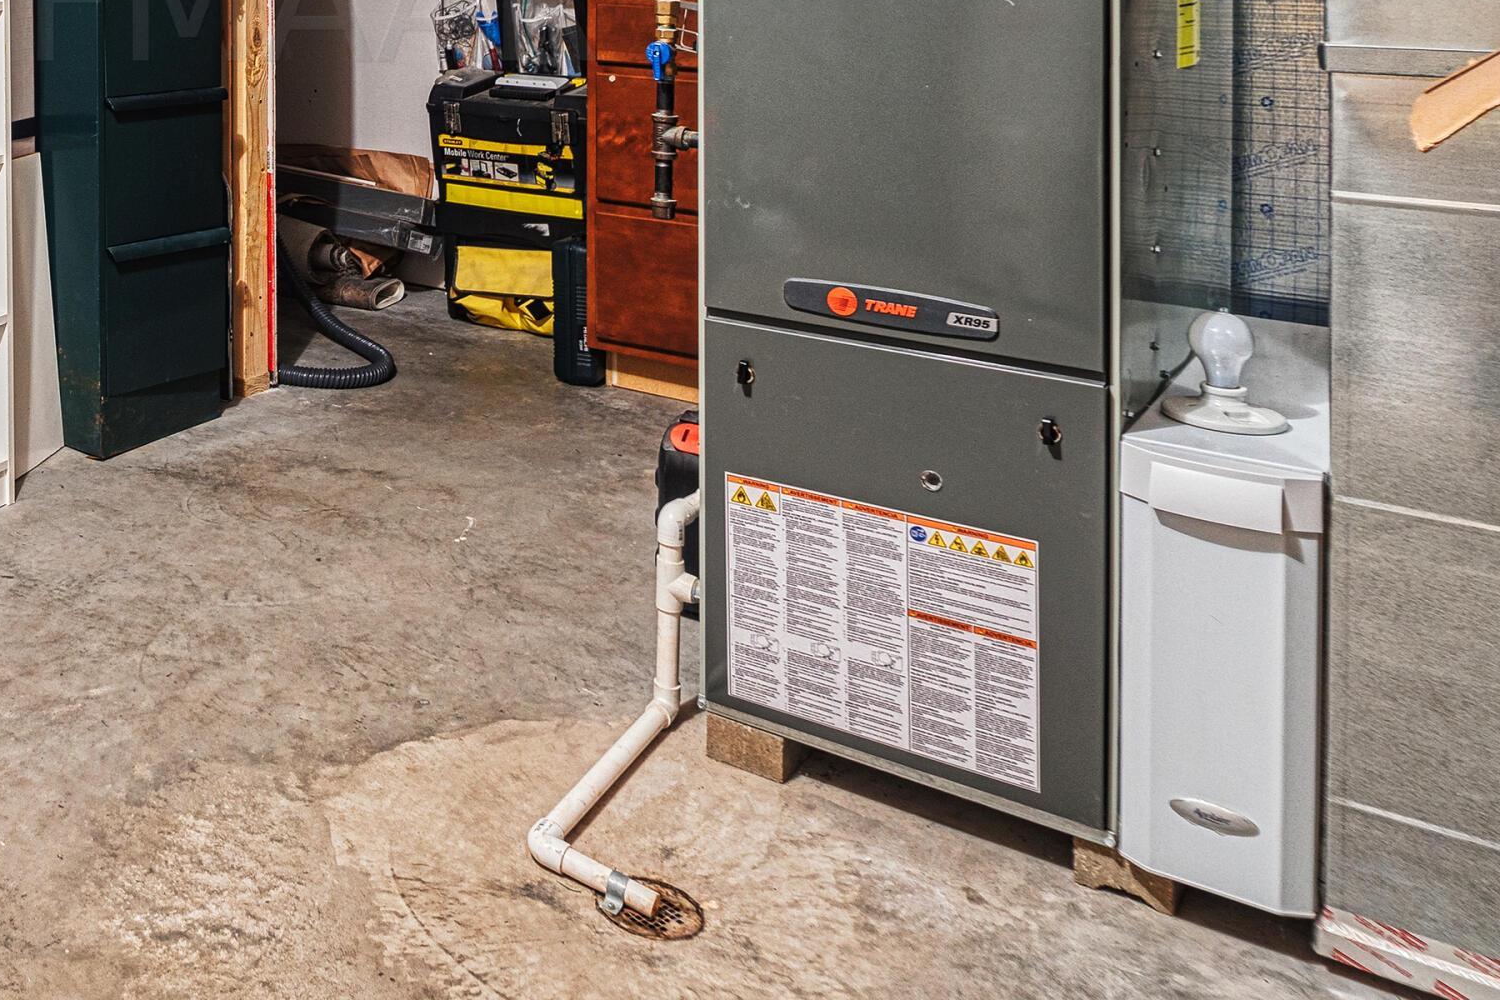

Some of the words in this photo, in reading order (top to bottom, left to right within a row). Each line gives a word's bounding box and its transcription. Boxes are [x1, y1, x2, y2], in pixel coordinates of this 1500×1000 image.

[444, 147, 467, 158] Mobile
[468, 150, 485, 159] Work
[485, 152, 506, 161] Center
[865, 299, 918, 319] TRANE
[953, 315, 991, 329] XR95
[789, 490, 837, 504] AVERTISSEMENT
[854, 504, 898, 519] ADVERTENCIA
